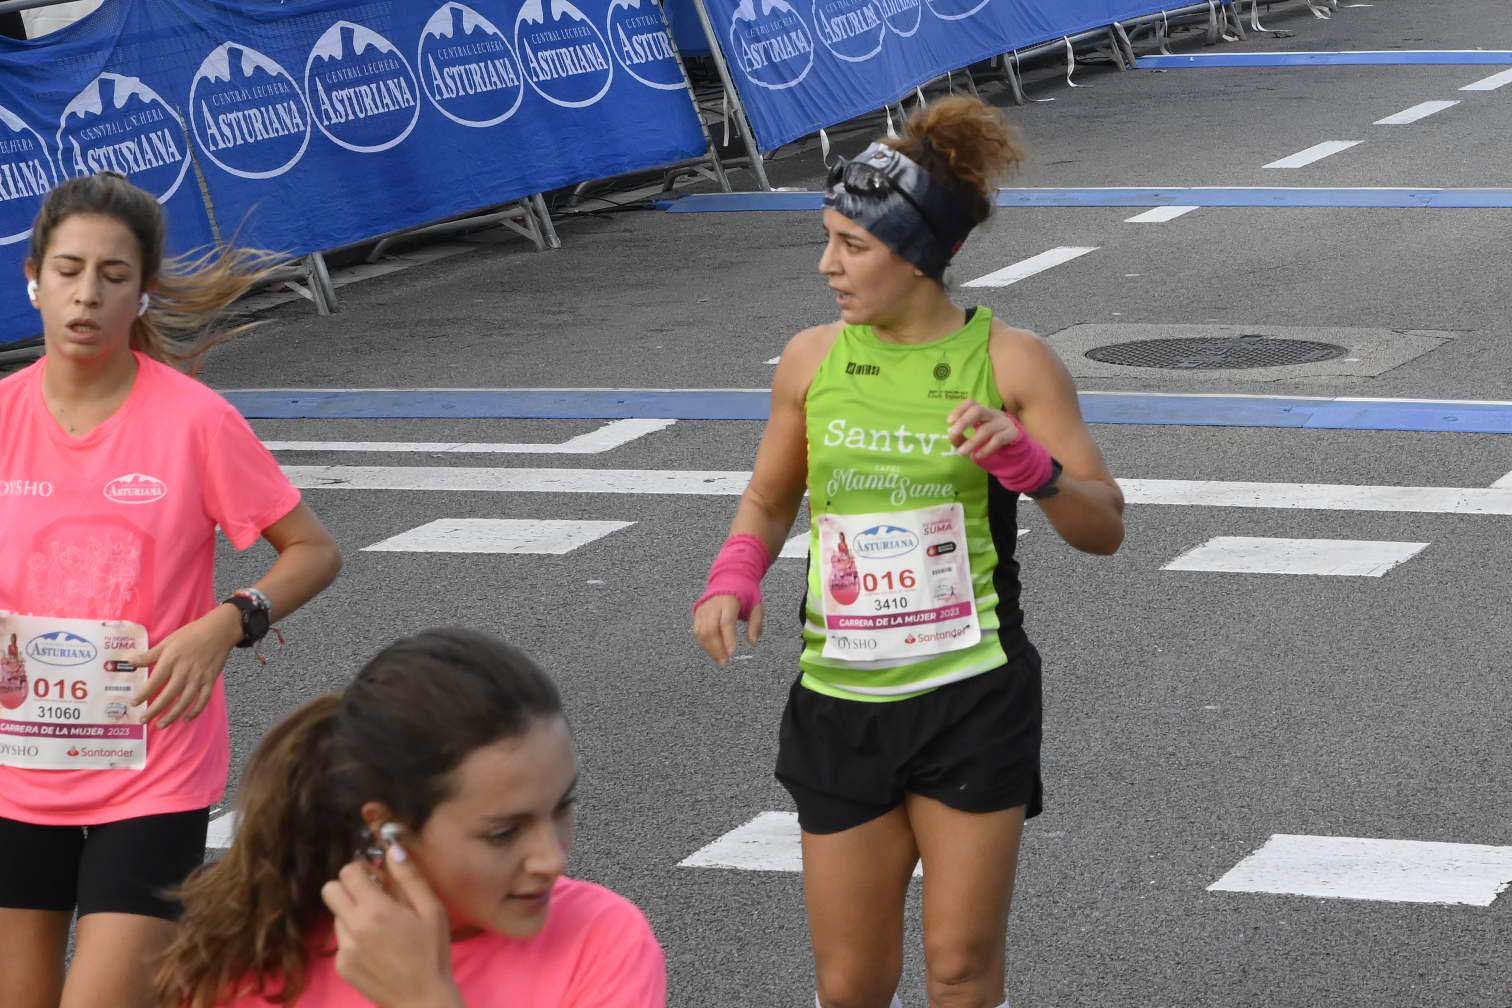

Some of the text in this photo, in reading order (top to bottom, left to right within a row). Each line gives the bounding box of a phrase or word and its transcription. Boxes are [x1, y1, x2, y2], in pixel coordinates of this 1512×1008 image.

[524, 37, 608, 83] ASTURIANA
[428, 53, 519, 101] ASTURIANA
[315, 76, 415, 127] ASTURIANA
[201, 98, 305, 152] ASTURIANA
[923, 524, 953, 535] SUMA
[857, 538, 914, 553] ASTURIANA
[863, 569, 916, 592] 016
[875, 596, 908, 611] 3410
[839, 618, 874, 627] CARRERA
[876, 618, 889, 626] DE
[891, 617, 902, 626] LA
[905, 611, 937, 623] MUJER
[918, 627, 968, 644] Santander
[32, 642, 92, 659] ASTURIANA
[104, 642, 137, 650] SUMA
[33, 678, 88, 700] 016
[38, 706, 81, 720] 31060
[41, 726, 54, 734] DE
[56, 727, 69, 735] LA
[71, 727, 104, 735] MUJER
[81, 747, 133, 758] Santander
